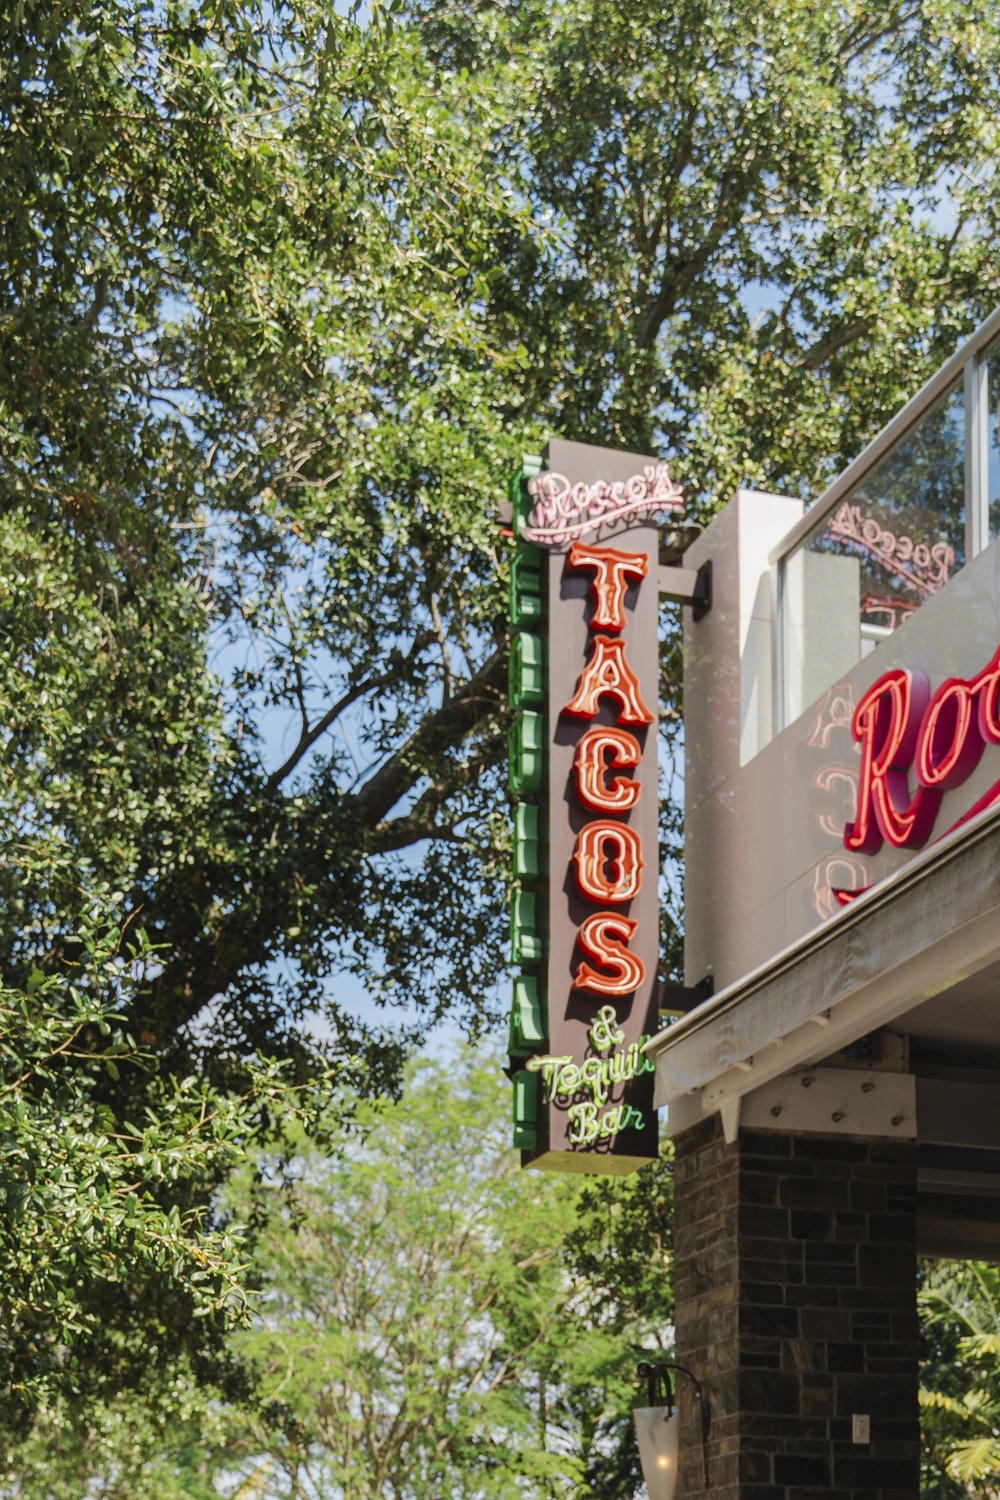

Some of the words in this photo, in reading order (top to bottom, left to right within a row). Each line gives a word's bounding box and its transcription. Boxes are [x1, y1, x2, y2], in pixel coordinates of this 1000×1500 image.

[530, 463, 684, 526] Rocco's
[563, 541, 654, 997] TACOS
[590, 1005, 626, 1050] &
[568, 1101, 646, 1145] Bar
